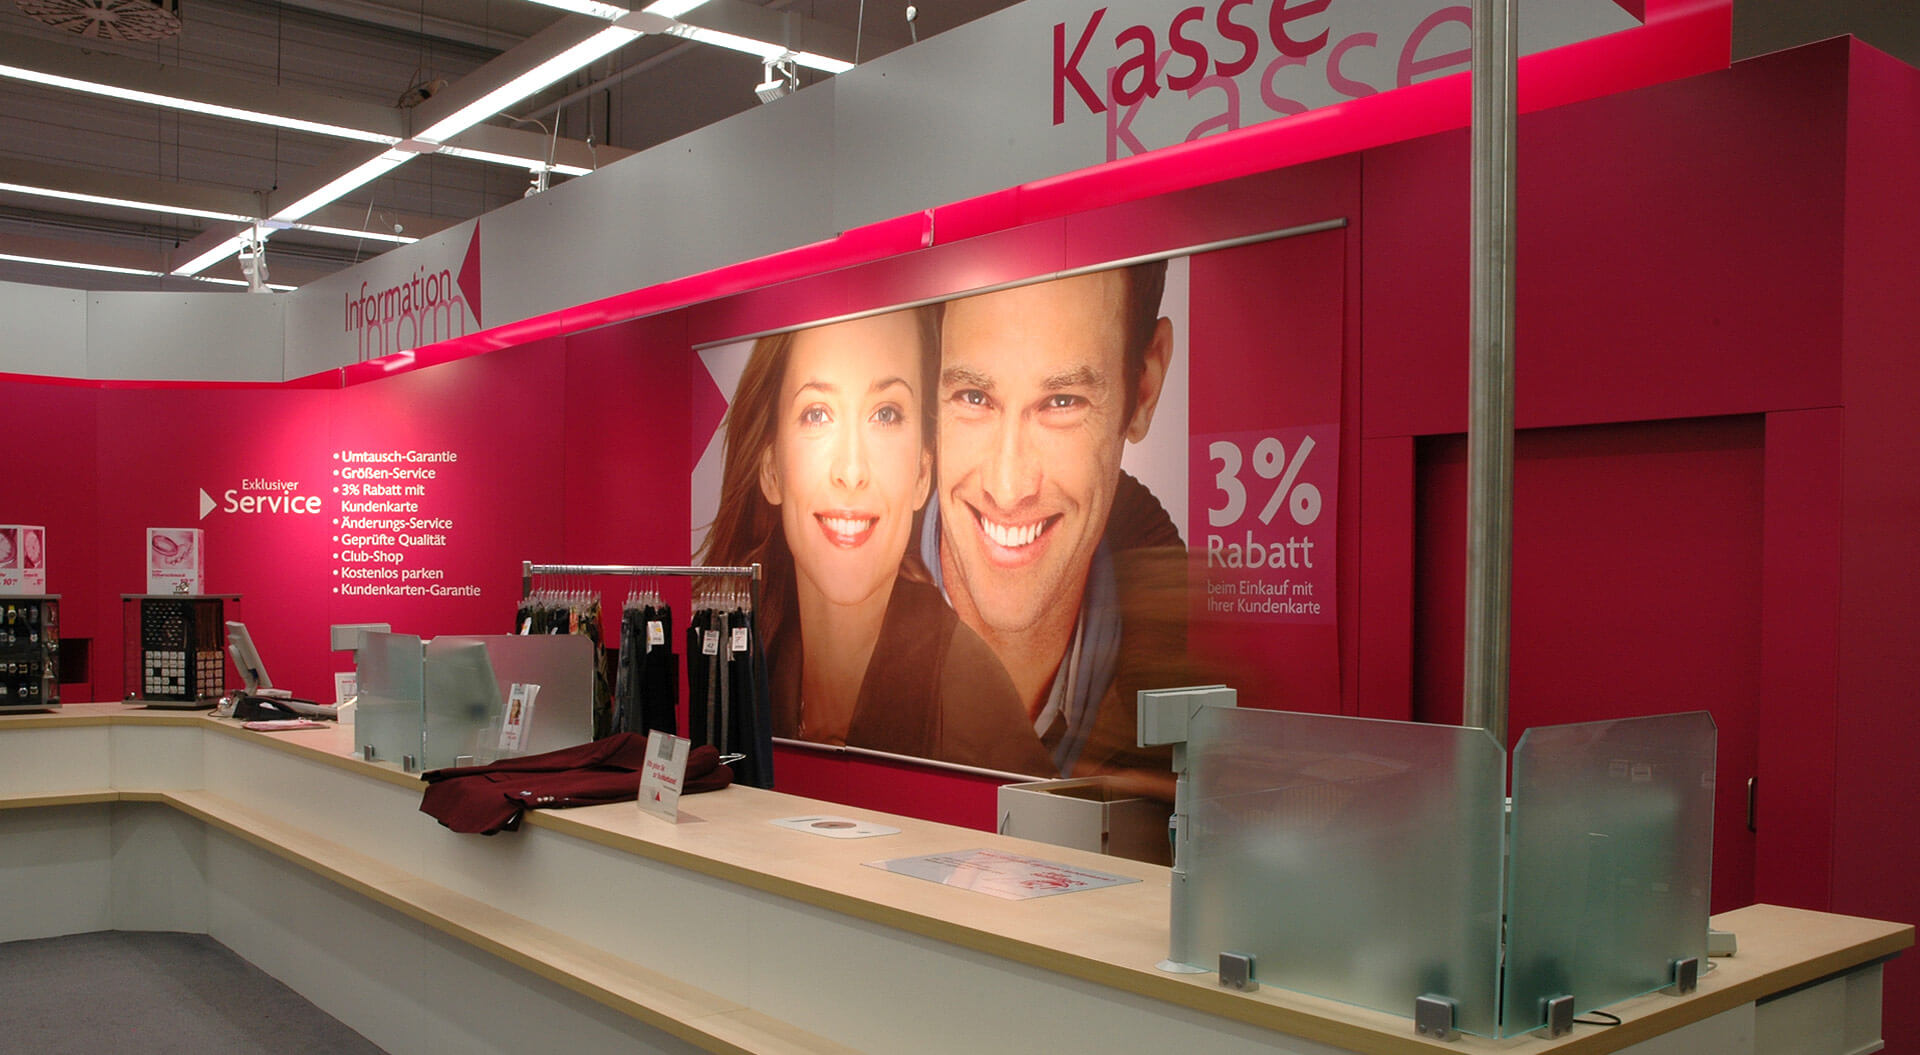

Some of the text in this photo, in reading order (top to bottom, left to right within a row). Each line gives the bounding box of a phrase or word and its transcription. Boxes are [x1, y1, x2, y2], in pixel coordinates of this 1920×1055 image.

[1053, 0, 1332, 126] Kasse
[345, 265, 452, 332] Information
[341, 450, 457, 463] Umtausch-Garantie
[341, 467, 436, 480] Größen-Service
[1208, 435, 1322, 527] 3%
[241, 478, 299, 491] Exklusiver
[341, 484, 425, 496] 3% Rabatt mit
[223, 489, 322, 514] Service
[341, 501, 418, 513] Kundenkarte
[341, 516, 453, 531] Änderungs-Service
[341, 533, 446, 548] Geprüfte Qualität
[1207, 530, 1314, 569] Rabatt
[341, 551, 404, 565] Club-Shop
[341, 567, 444, 582] Kostenlos parken
[341, 584, 481, 597] Kundenkarten-Garantie
[1207, 579, 1313, 596] beim Einkauf mit
[1207, 597, 1321, 615] Ihrer Kundenkarte
